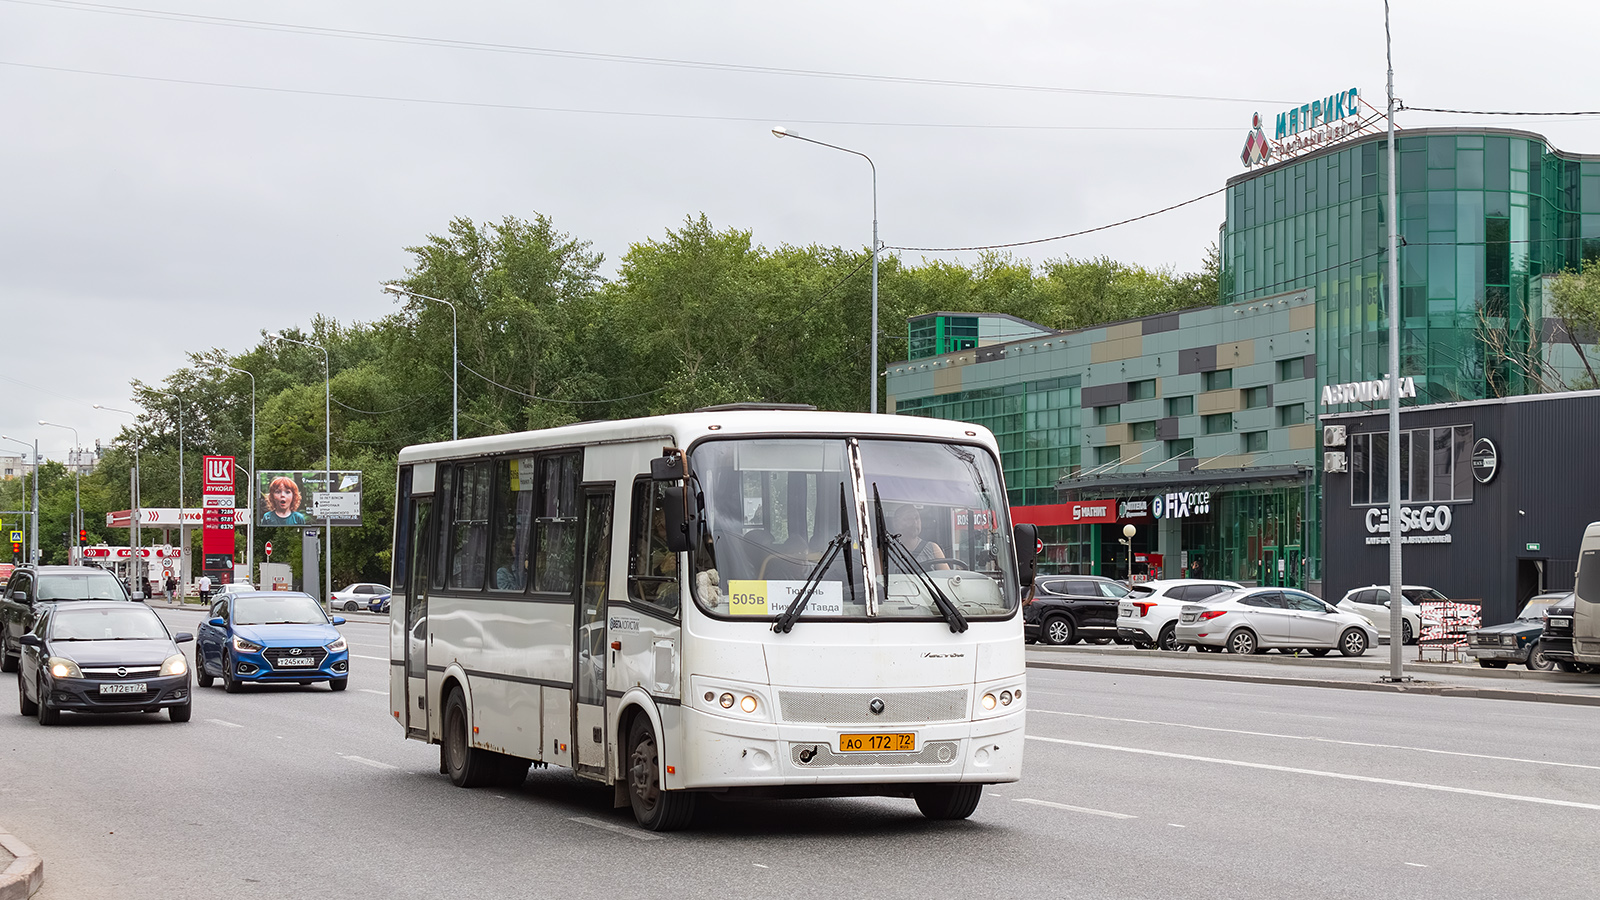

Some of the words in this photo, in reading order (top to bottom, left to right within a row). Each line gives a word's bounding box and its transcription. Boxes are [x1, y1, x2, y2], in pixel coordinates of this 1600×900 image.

[1275, 87, 1360, 140] МАТРИКС
[1189, 491, 1210, 508] price
[1081, 506, 1107, 517] МАГНИТ
[786, 586, 824, 595] Тюень
[732, 594, 765, 605] 505в
[811, 603, 839, 612] Тавда
[846, 739, 862, 749] АО
[869, 736, 891, 749] 172
[898, 734, 911, 745] 72
